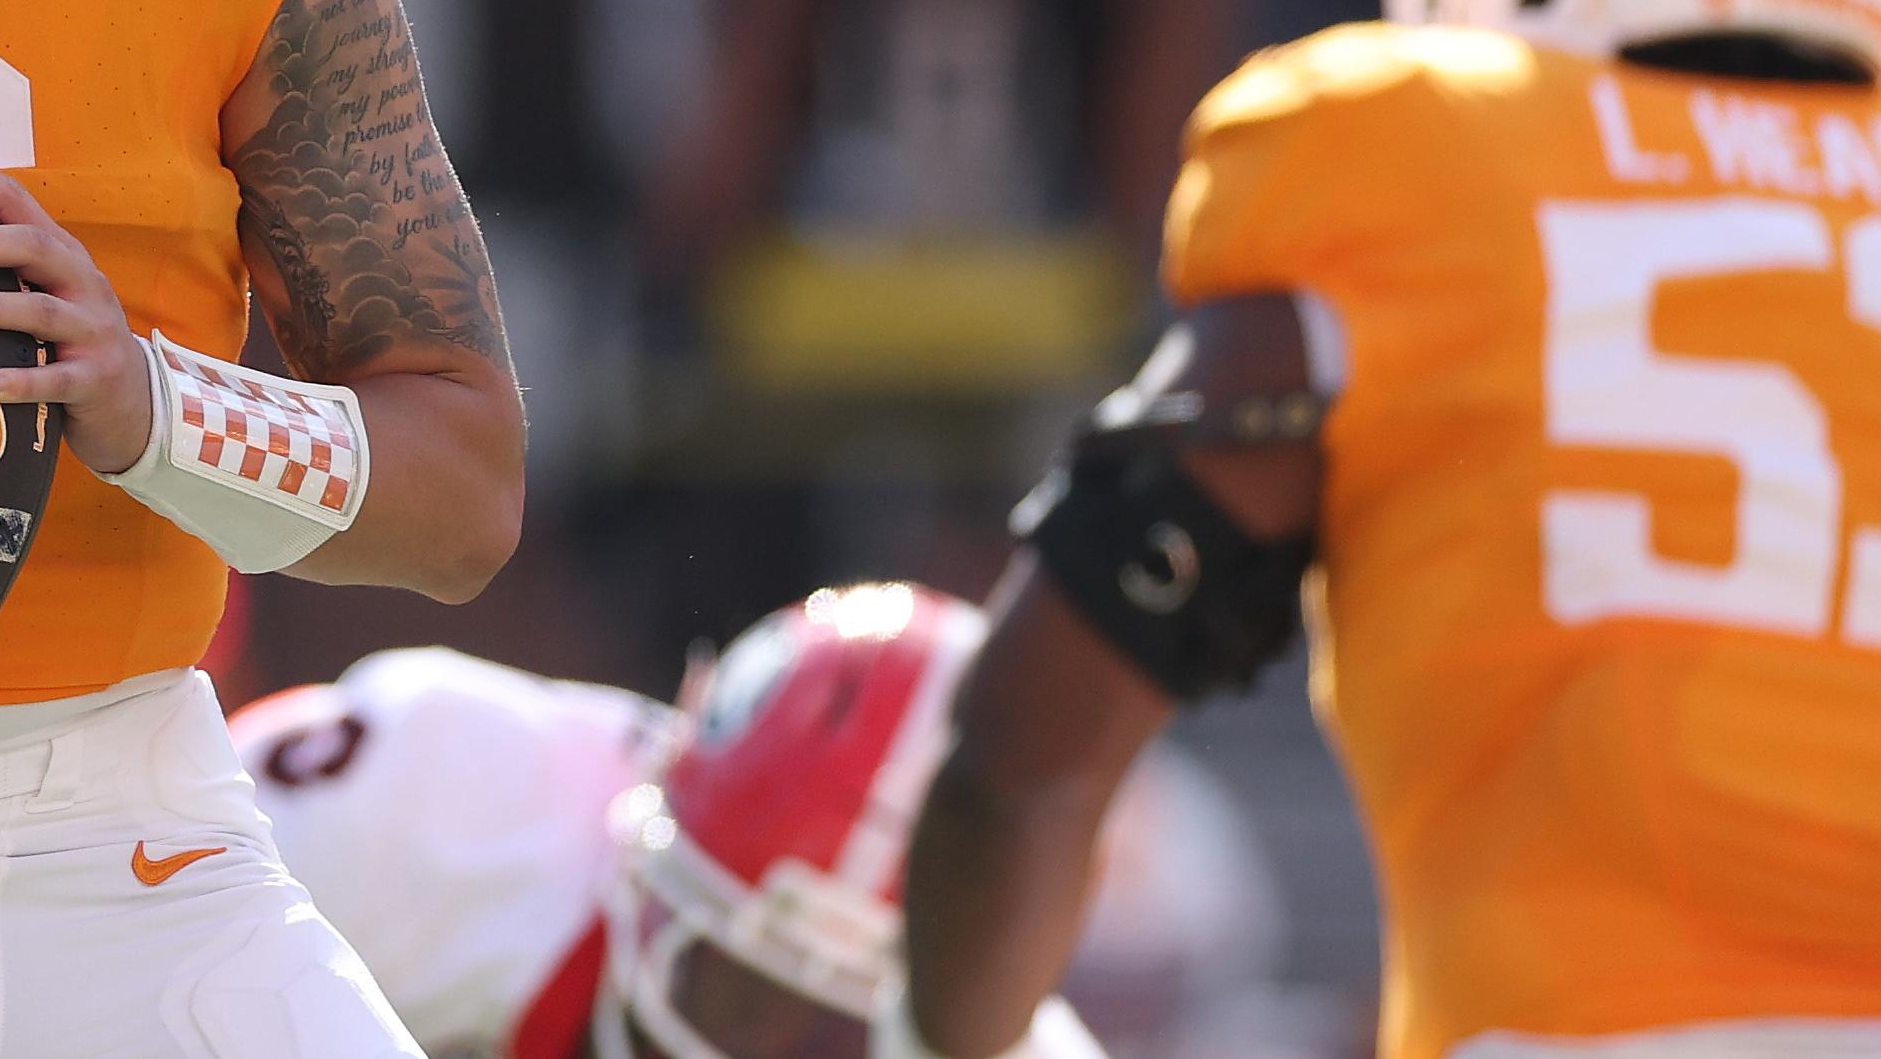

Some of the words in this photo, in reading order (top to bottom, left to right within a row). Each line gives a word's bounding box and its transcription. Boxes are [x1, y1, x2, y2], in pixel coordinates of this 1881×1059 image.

[327, 63, 359, 96] my
[340, 94, 371, 125] my
[343, 113, 412, 155] promise
[1688, 88, 1881, 202] HEA
[370, 151, 394, 186] by
[393, 181, 415, 204] be
[392, 213, 439, 250] you
[1535, 195, 1881, 650] 5
